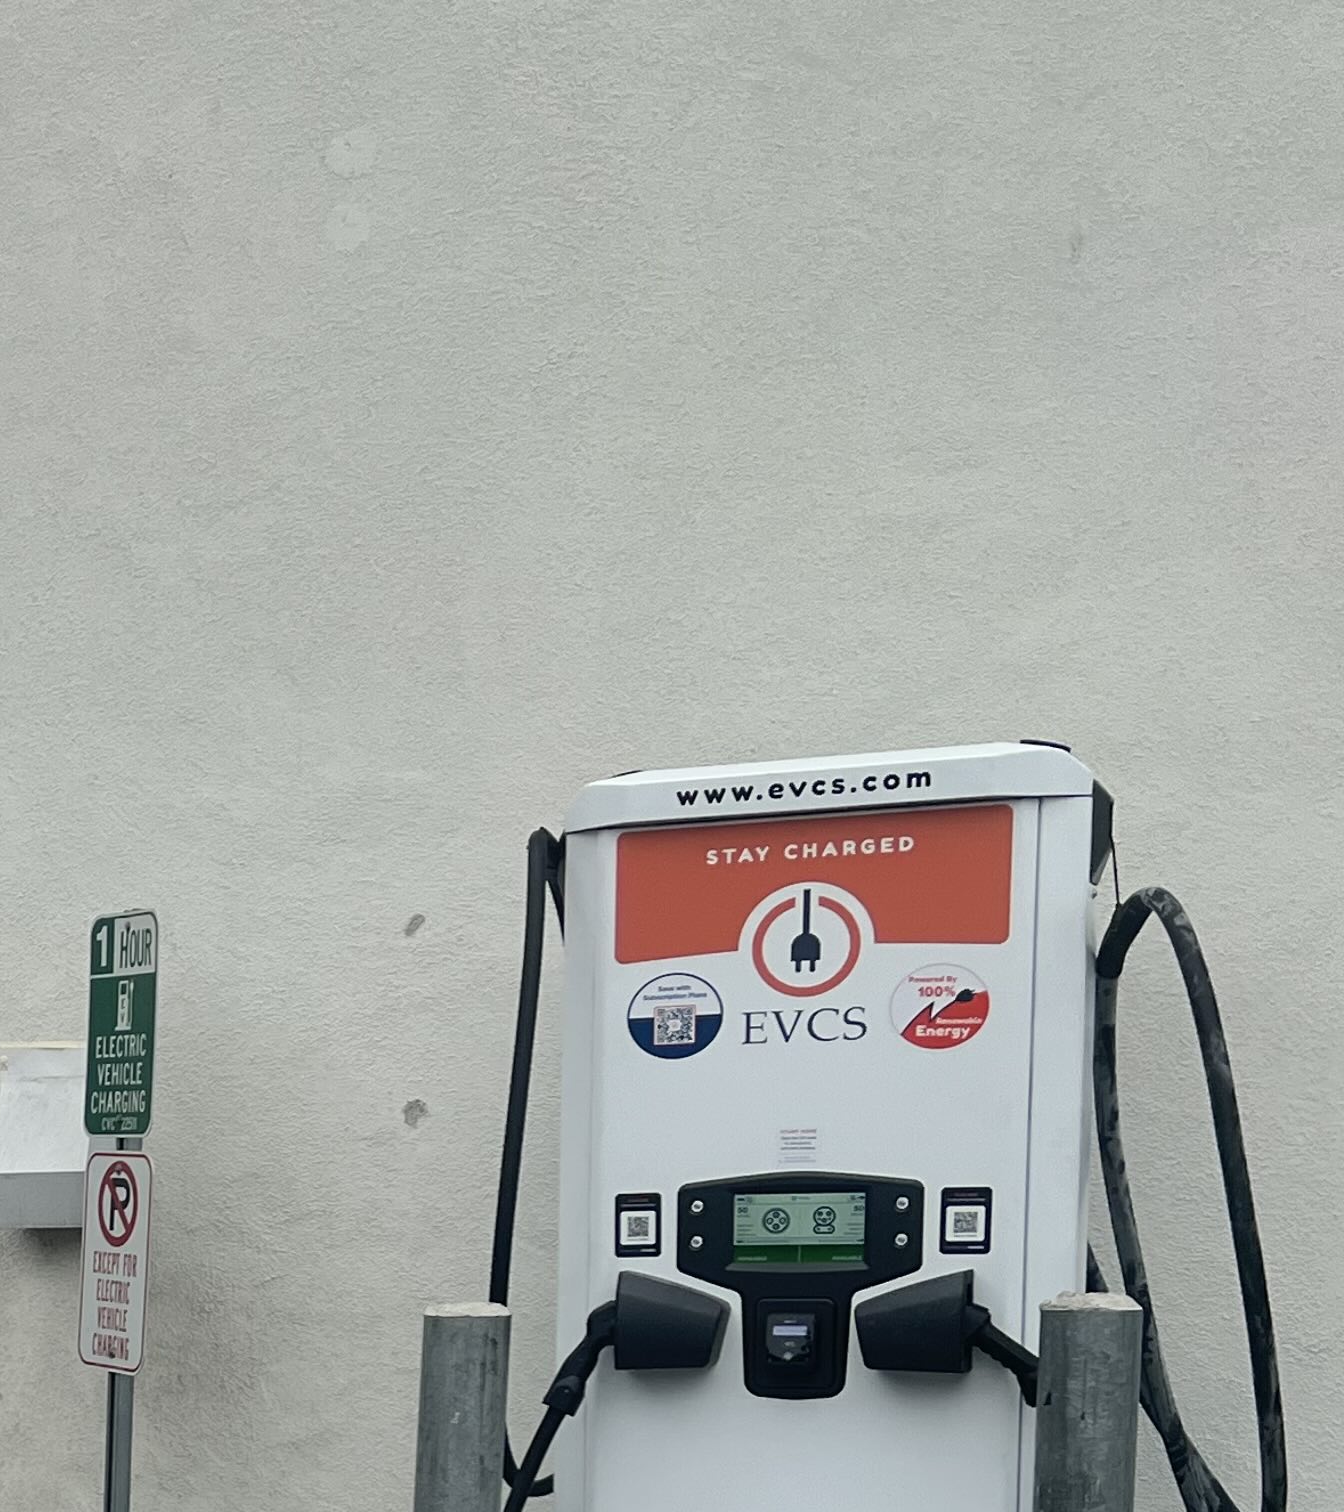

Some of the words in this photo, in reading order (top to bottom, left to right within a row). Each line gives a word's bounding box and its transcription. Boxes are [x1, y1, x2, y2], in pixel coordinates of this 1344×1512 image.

[676, 771, 932, 806] www.evcs.com
[705, 845, 770, 865] STAY
[783, 836, 914, 860] CHARGED
[96, 925, 108, 967] 1
[119, 928, 152, 968] HOUR
[918, 986, 956, 998] 100%
[741, 1005, 868, 1046] EVCS
[915, 1025, 971, 1040] Energy
[95, 1033, 147, 1058] ELECTRIC
[97, 1062, 143, 1086] VEHICLE
[91, 1090, 146, 1114] CHARGING
[93, 1251, 120, 1275] EXCEPT
[96, 1278, 130, 1304] ELECTRIC
[97, 1306, 128, 1332] VEHICLE
